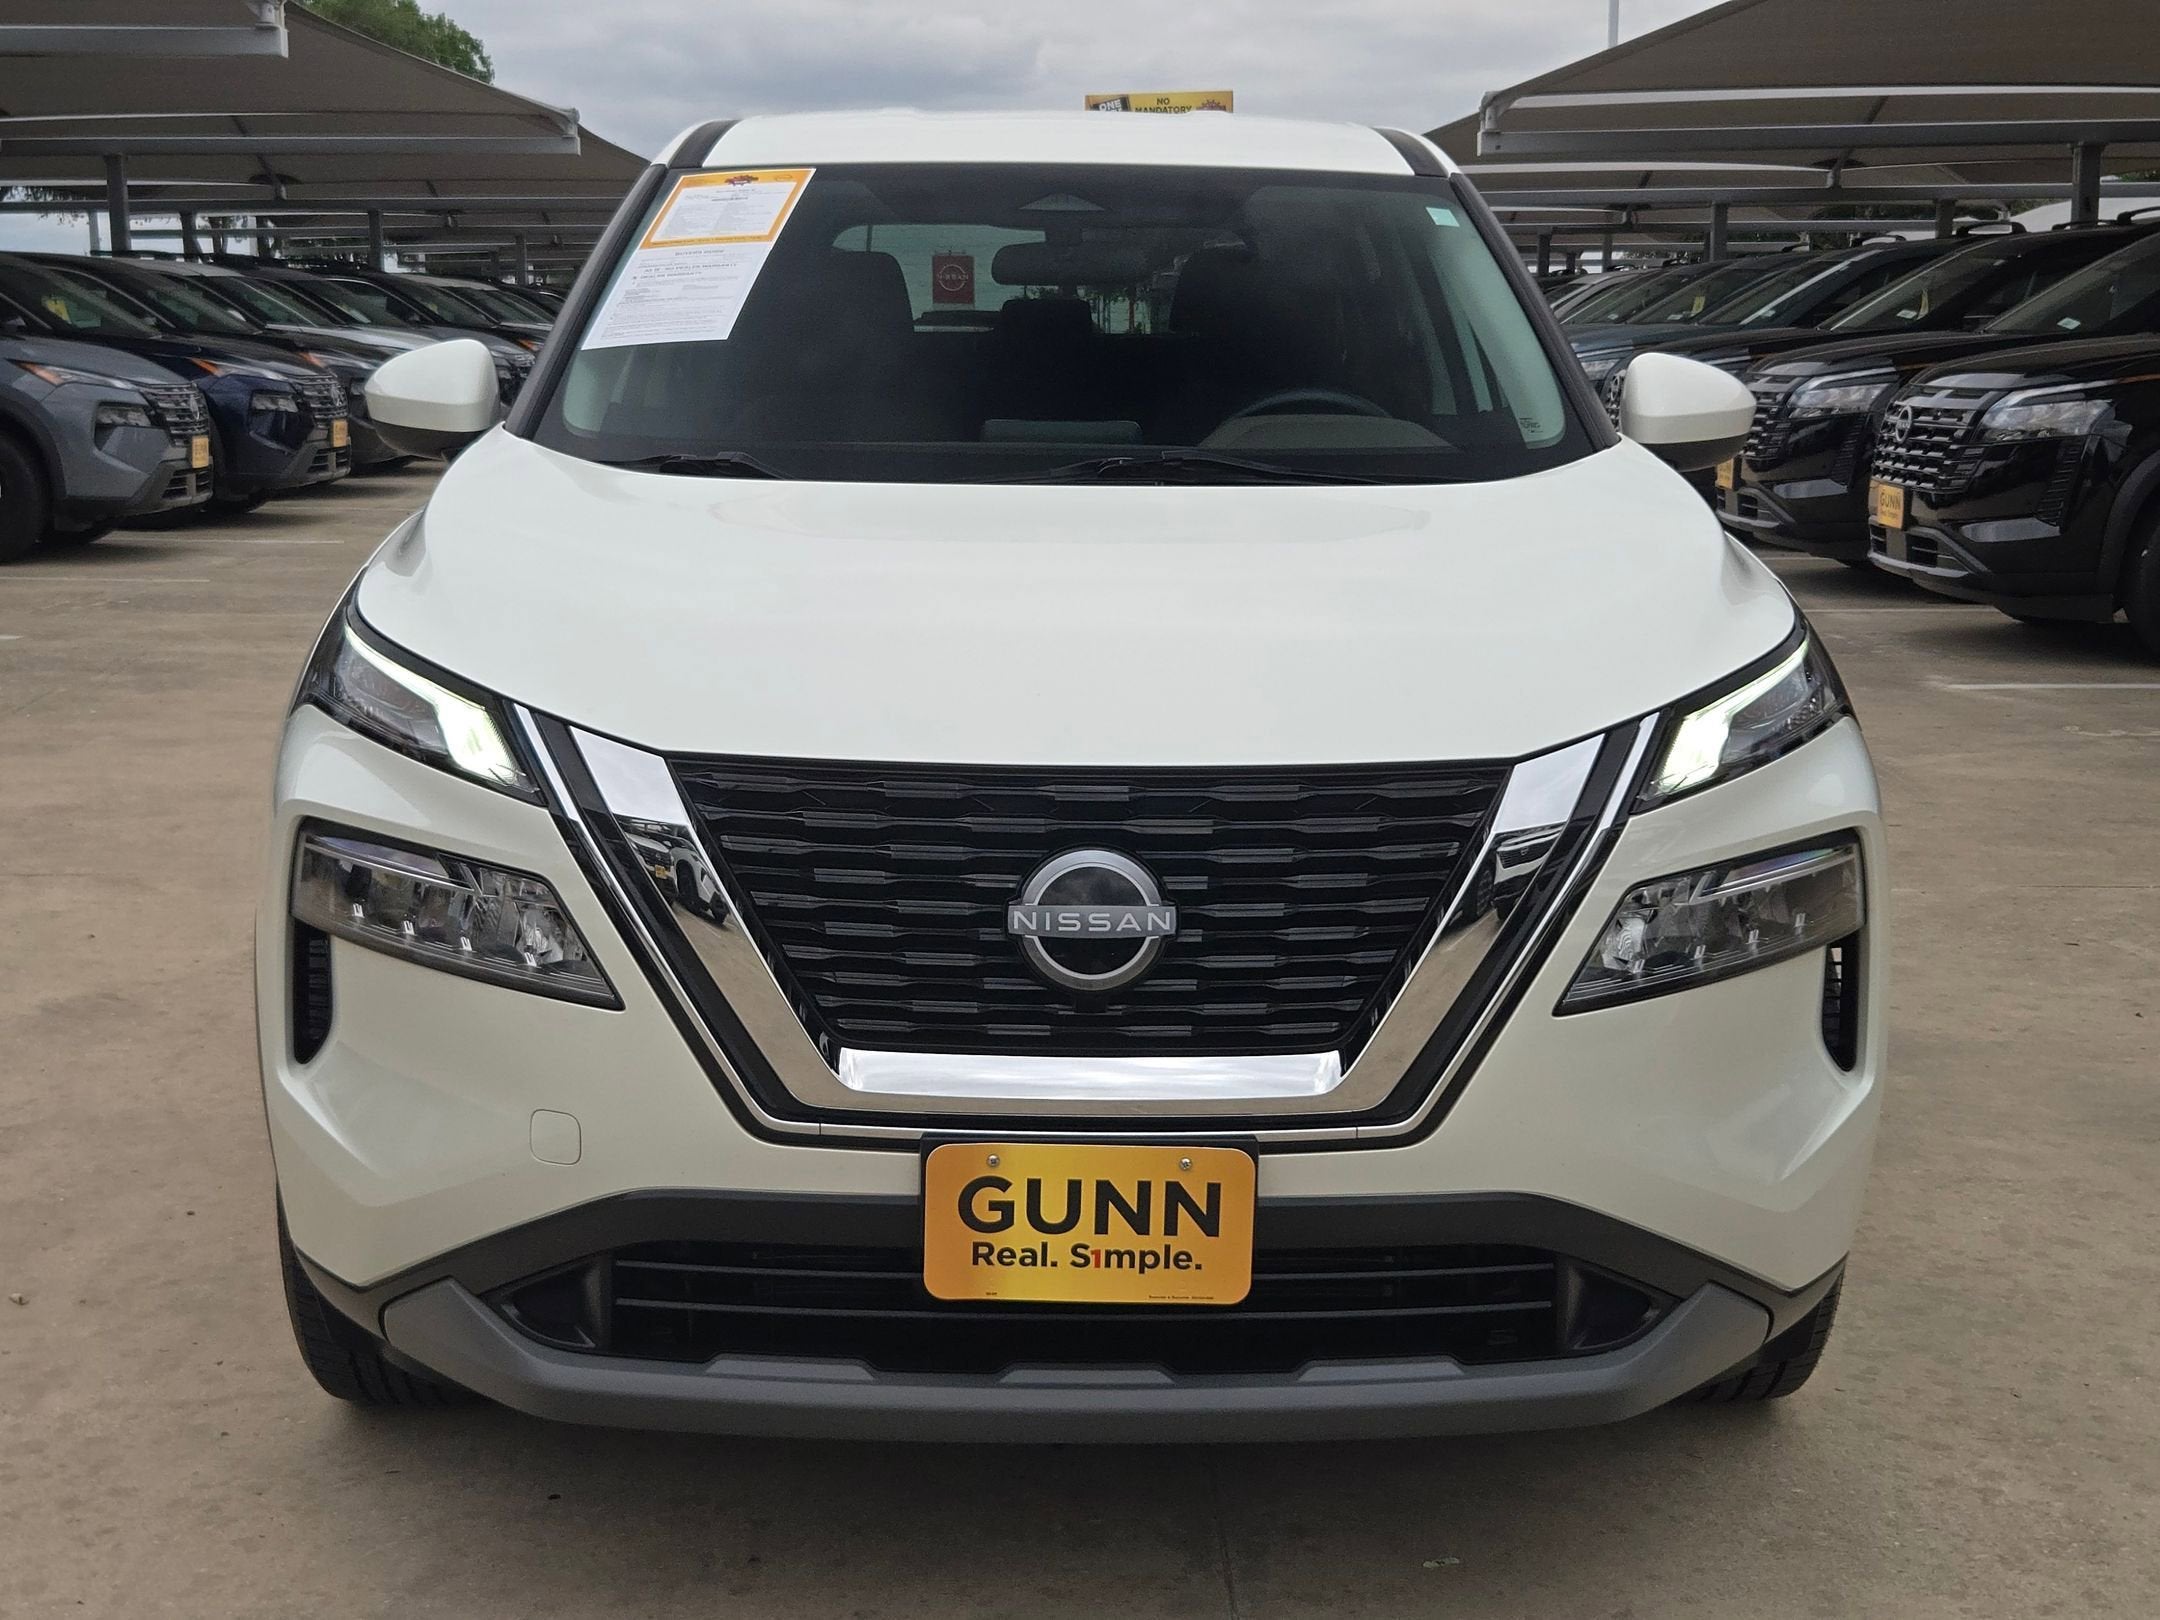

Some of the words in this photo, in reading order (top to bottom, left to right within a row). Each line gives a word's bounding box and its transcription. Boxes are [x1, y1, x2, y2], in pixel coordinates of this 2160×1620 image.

[1099, 99, 1121, 111] ONE
[1135, 105, 1193, 114] MANDATORY
[1156, 97, 1170, 106] NO
[1880, 493, 1901, 510] GUNN
[1013, 911, 1171, 932] NISSAN
[957, 1175, 1222, 1238] GUNN
[972, 1241, 1058, 1268] Real.
[1070, 1243, 1203, 1275] S1mple.
